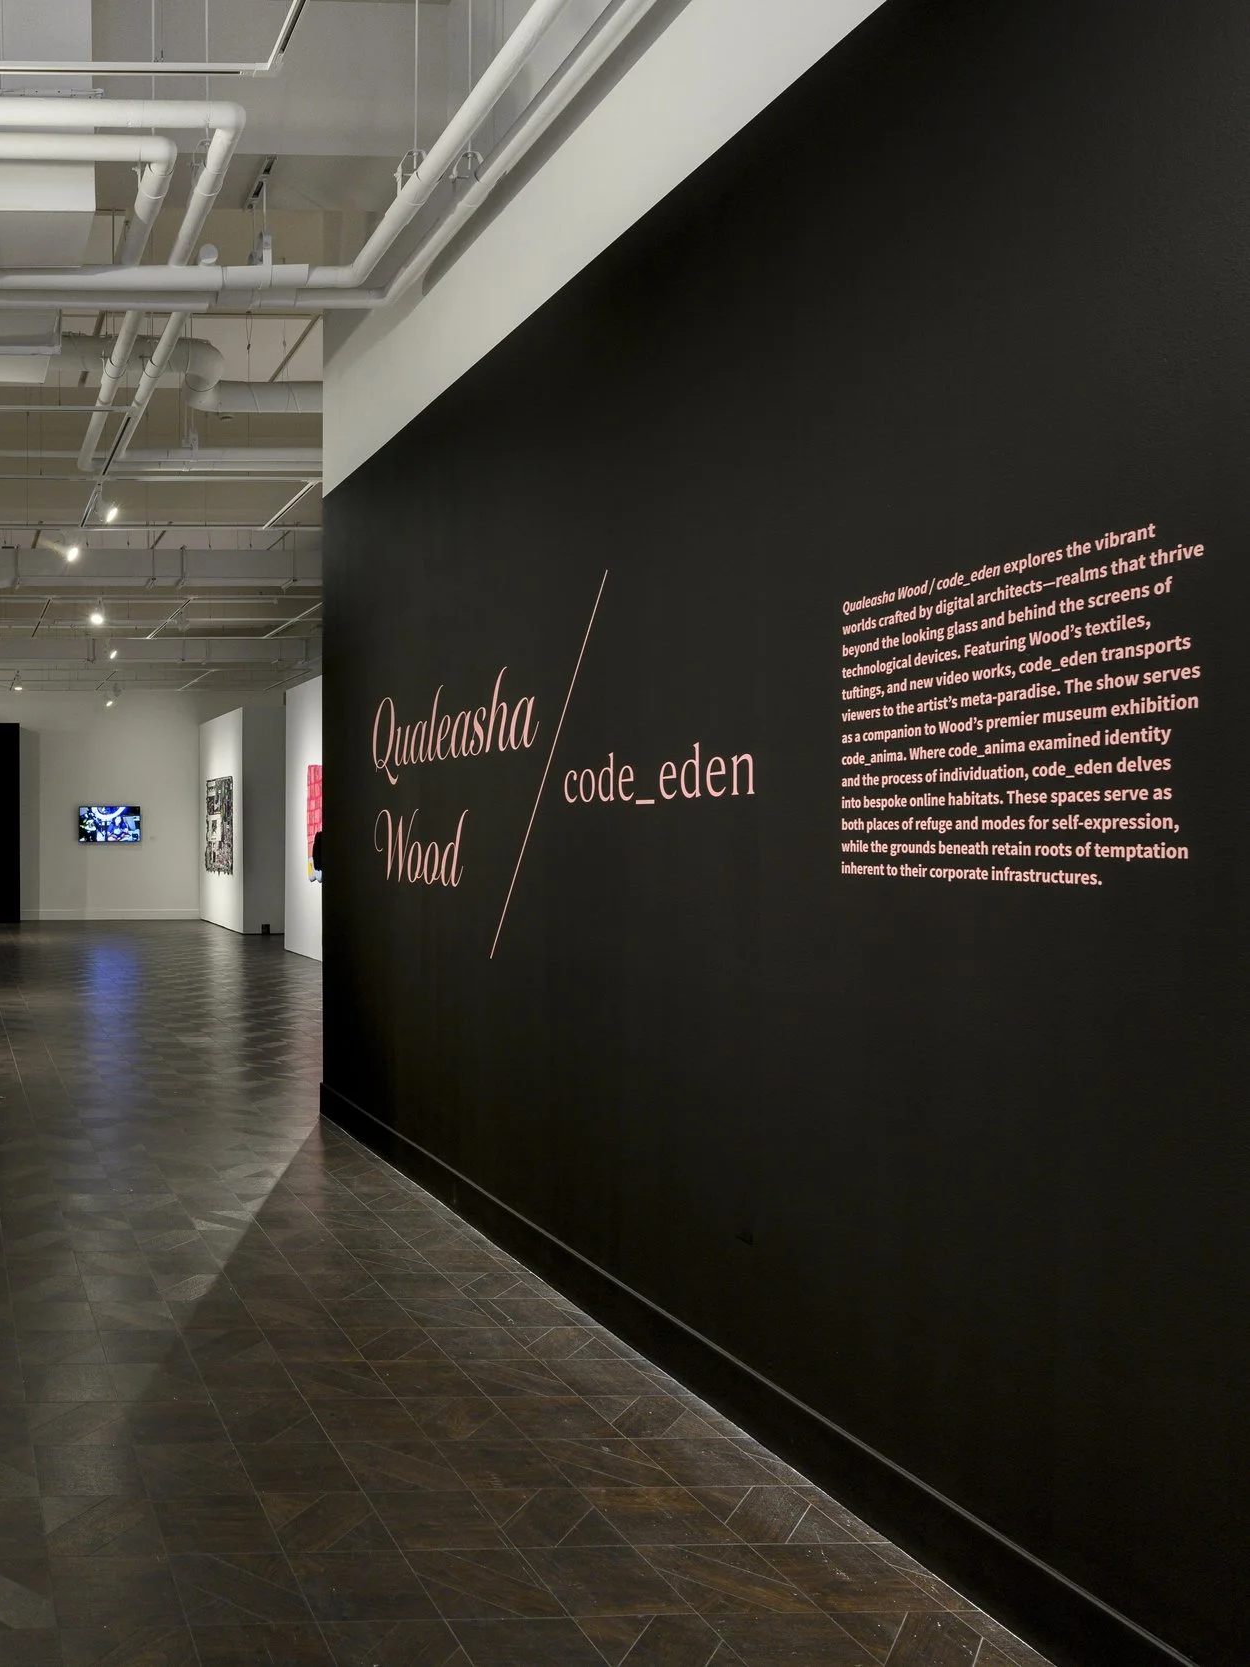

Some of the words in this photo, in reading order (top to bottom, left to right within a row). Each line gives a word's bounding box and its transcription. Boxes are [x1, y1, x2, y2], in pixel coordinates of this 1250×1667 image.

[842, 591, 896, 616] Qualeasha
[898, 580, 929, 600] Wood
[936, 565, 1001, 591] code_eden
[1003, 549, 1063, 574] explores
[1066, 542, 1092, 558] the
[1095, 524, 1156, 551] vibrant
[842, 617, 877, 636] worlds
[878, 607, 917, 628] crafted
[919, 605, 934, 621] by
[935, 593, 975, 616] digital
[1111, 555, 1146, 576] that
[1149, 544, 1204, 567] thrive
[842, 638, 880, 658] beyond
[881, 636, 900, 649] the
[902, 627, 945, 646] looking
[947, 621, 979, 640] glass
[981, 611, 1005, 630] and
[1008, 600, 1056, 625] behind
[1059, 598, 1085, 614] the
[1088, 586, 1150, 609] screens
[1154, 576, 1173, 595] of
[842, 654, 912, 679] technological
[914, 649, 961, 667] devices.
[964, 636, 1027, 658] Featuring
[1085, 614, 1151, 637] textiles,
[842, 685, 885, 701] tuftings,
[887, 678, 908, 694] and
[910, 678, 934, 691] new
[936, 671, 970, 687] video
[972, 663, 1016, 681] works,
[1019, 651, 1098, 674] code_eden
[1101, 636, 1191, 662] transports
[842, 708, 881, 722] viewers
[882, 705, 895, 717] to
[896, 702, 915, 716] the
[960, 683, 1061, 708] meta-paradise.
[1064, 678, 1093, 694] The
[1096, 674, 1140, 691] show
[1143, 666, 1201, 685] serves
[372, 666, 540, 785] Qualeasha
[841, 749, 907, 766] code_anima.
[909, 746, 946, 761] Where
[948, 739, 1026, 758] code_anima
[1028, 731, 1101, 752] examined
[1105, 726, 1172, 746] identity
[842, 734, 853, 744] as
[854, 733, 861, 743] a
[862, 724, 922, 743] companion
[924, 724, 937, 736] to
[986, 711, 1040, 733] premier
[1043, 706, 1107, 724] museum
[1111, 694, 1199, 717] exhibition
[564, 742, 755, 804] code_eden
[841, 774, 861, 788] and
[862, 773, 880, 786] the
[881, 774, 923, 789] process
[925, 769, 938, 783] of
[939, 764, 1029, 783] individuation,
[1032, 759, 1113, 779] code_eden
[1116, 756, 1172, 773] delves
[842, 796, 862, 809] into
[863, 795, 908, 811] bespoke
[909, 793, 946, 807] online
[948, 791, 1004, 806] habitats.
[1006, 790, 1048, 804] These
[1051, 791, 1101, 807] spaces
[1104, 789, 1149, 802] serve
[1153, 788, 1172, 801] as
[374, 808, 469, 888] Wood
[841, 840, 869, 853] while
[870, 840, 889, 853] the
[890, 841, 937, 857] grounds
[938, 841, 989, 855] beneath
[992, 841, 1032, 856] retain
[1035, 843, 1073, 857] roots
[1075, 842, 1092, 857] of
[1094, 842, 1189, 862] temptation
[842, 818, 865, 831] both
[866, 818, 900, 834] places
[901, 817, 914, 831] of
[915, 817, 953, 834] refuge
[955, 816, 979, 830] and
[981, 816, 1026, 830] modes
[1028, 815, 1050, 830] for
[1052, 813, 1180, 834] self-expression,
[841, 861, 885, 876] inherent
[886, 864, 898, 877] to
[900, 864, 928, 878] their
[929, 867, 989, 882] corporate
[991, 866, 1103, 886] infrastructures.
